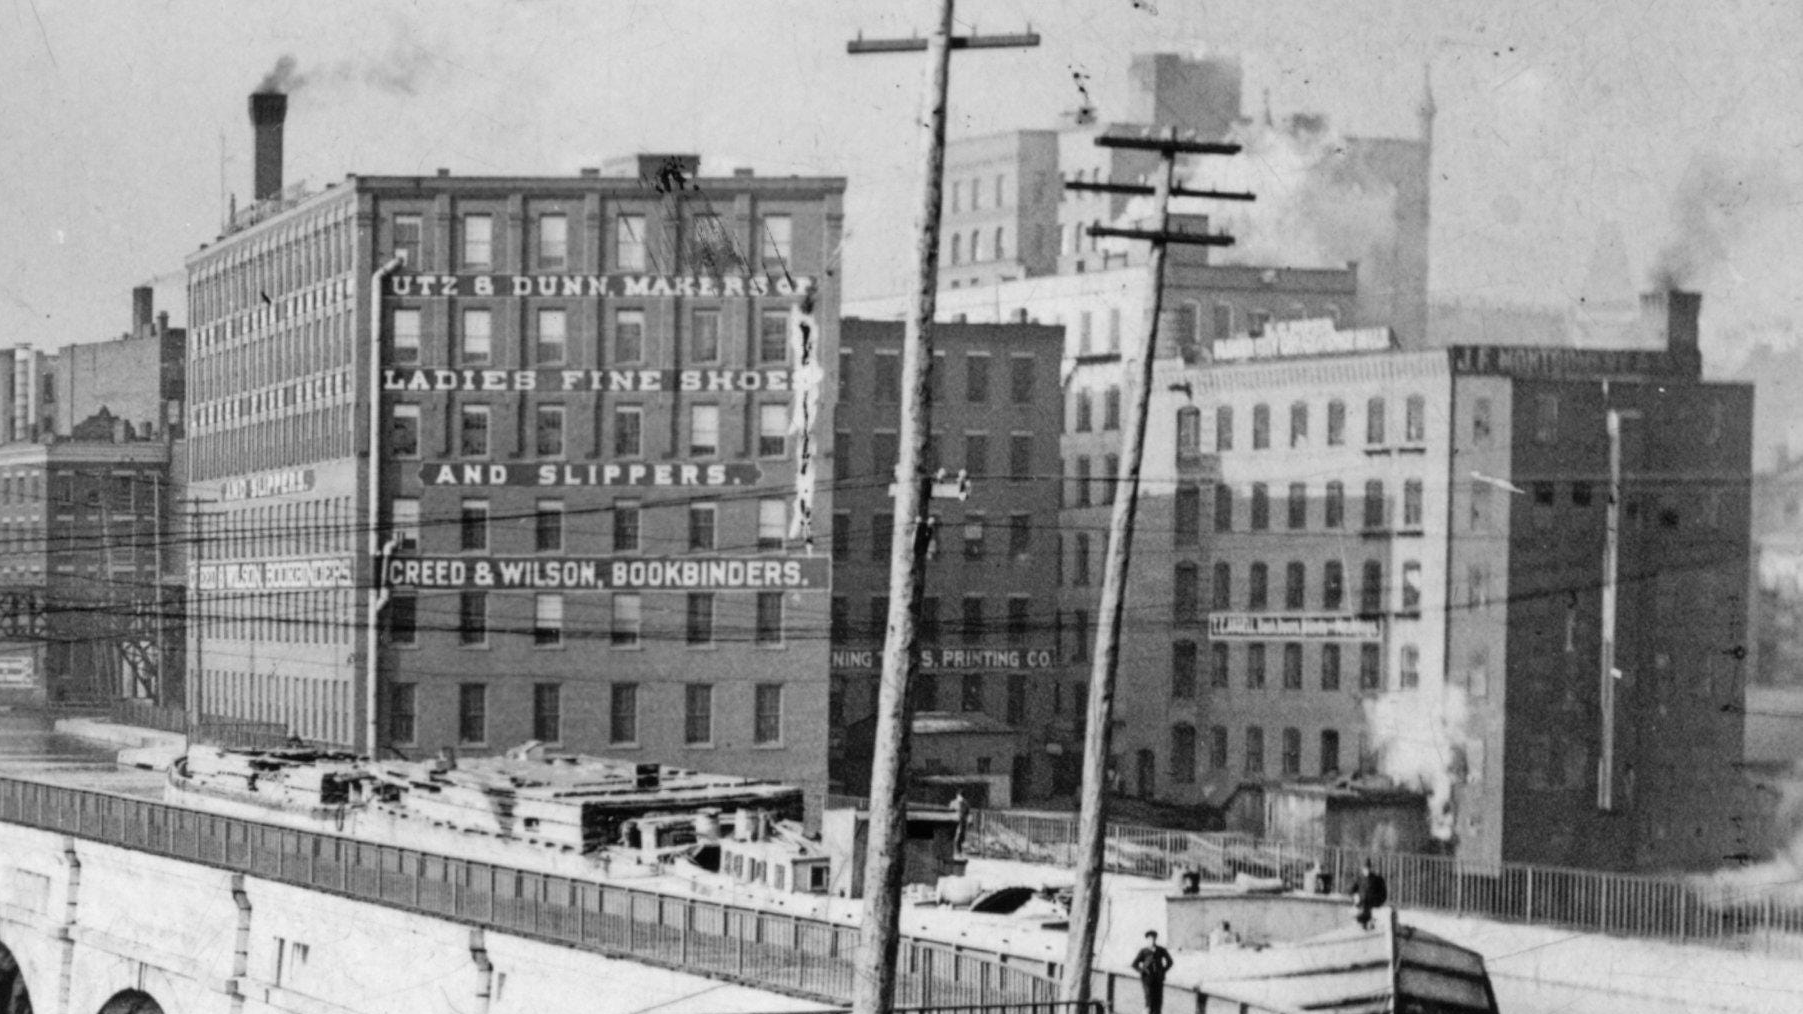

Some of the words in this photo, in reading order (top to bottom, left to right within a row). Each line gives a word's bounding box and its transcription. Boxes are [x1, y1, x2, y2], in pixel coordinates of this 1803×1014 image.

[392, 276, 458, 295] UTZ
[474, 276, 494, 295] &
[623, 276, 768, 296] MAKERS
[776, 276, 811, 296] OF
[384, 370, 536, 390] LADIES
[561, 370, 662, 390] FINE
[437, 464, 507, 485] AND
[539, 464, 742, 485] SLIPPERS.
[389, 560, 466, 585] CREED
[473, 560, 494, 586] &
[499, 561, 604, 590] WILSON,
[612, 561, 809, 587] BOOKBINDERS.
[942, 651, 1020, 668] PRINTING
